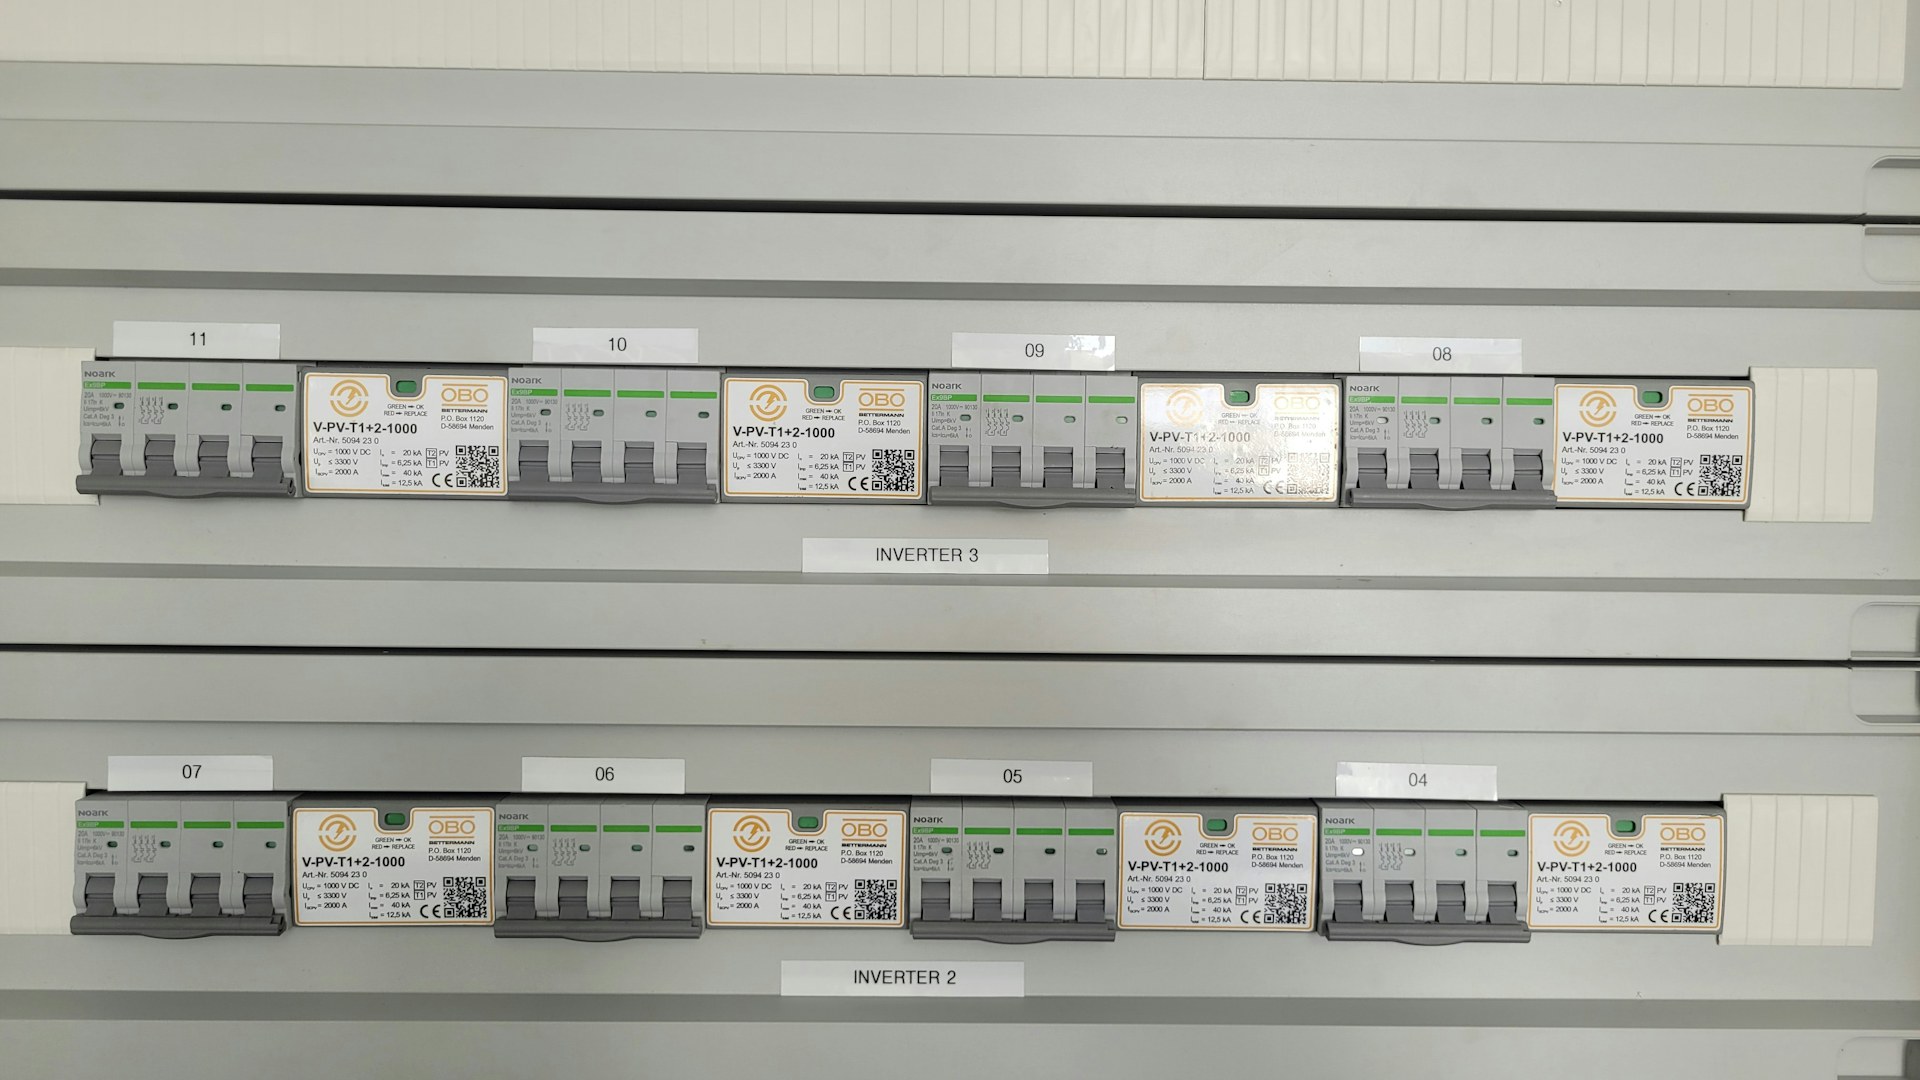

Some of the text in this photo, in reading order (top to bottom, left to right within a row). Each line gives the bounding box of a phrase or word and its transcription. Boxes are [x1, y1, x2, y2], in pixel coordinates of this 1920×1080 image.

[190, 331, 206, 346] 11
[608, 337, 627, 352] 10
[1025, 343, 1045, 358] 09
[1432, 347, 1452, 361] 08
[441, 387, 488, 403] OBO
[859, 392, 905, 407] OBO
[1275, 396, 1321, 410] OBO
[1688, 397, 1735, 413] OBO
[313, 421, 418, 434] V-PV-T1+2-1000
[733, 426, 835, 438] V-PV-T1+2-1000
[1562, 432, 1664, 444] V-PV-T1+2-1000
[876, 547, 979, 563] INVERTER 3
[182, 764, 202, 779] 07
[595, 766, 615, 782] 06
[1003, 768, 1023, 784] 05
[1409, 772, 1427, 786] 04
[429, 820, 475, 834] OBO
[842, 822, 888, 838] OBO
[1253, 826, 1299, 842] OBO
[1661, 827, 1707, 841] OBO
[302, 857, 405, 867] V-PV-T1+2-1000
[716, 857, 818, 869] V-PV-T1+2-1000
[1128, 861, 1229, 872] V-PV-T1+2-1000
[1537, 861, 1637, 872] V-PV-T1+2-1000
[854, 969, 956, 985] INVERTER 2
